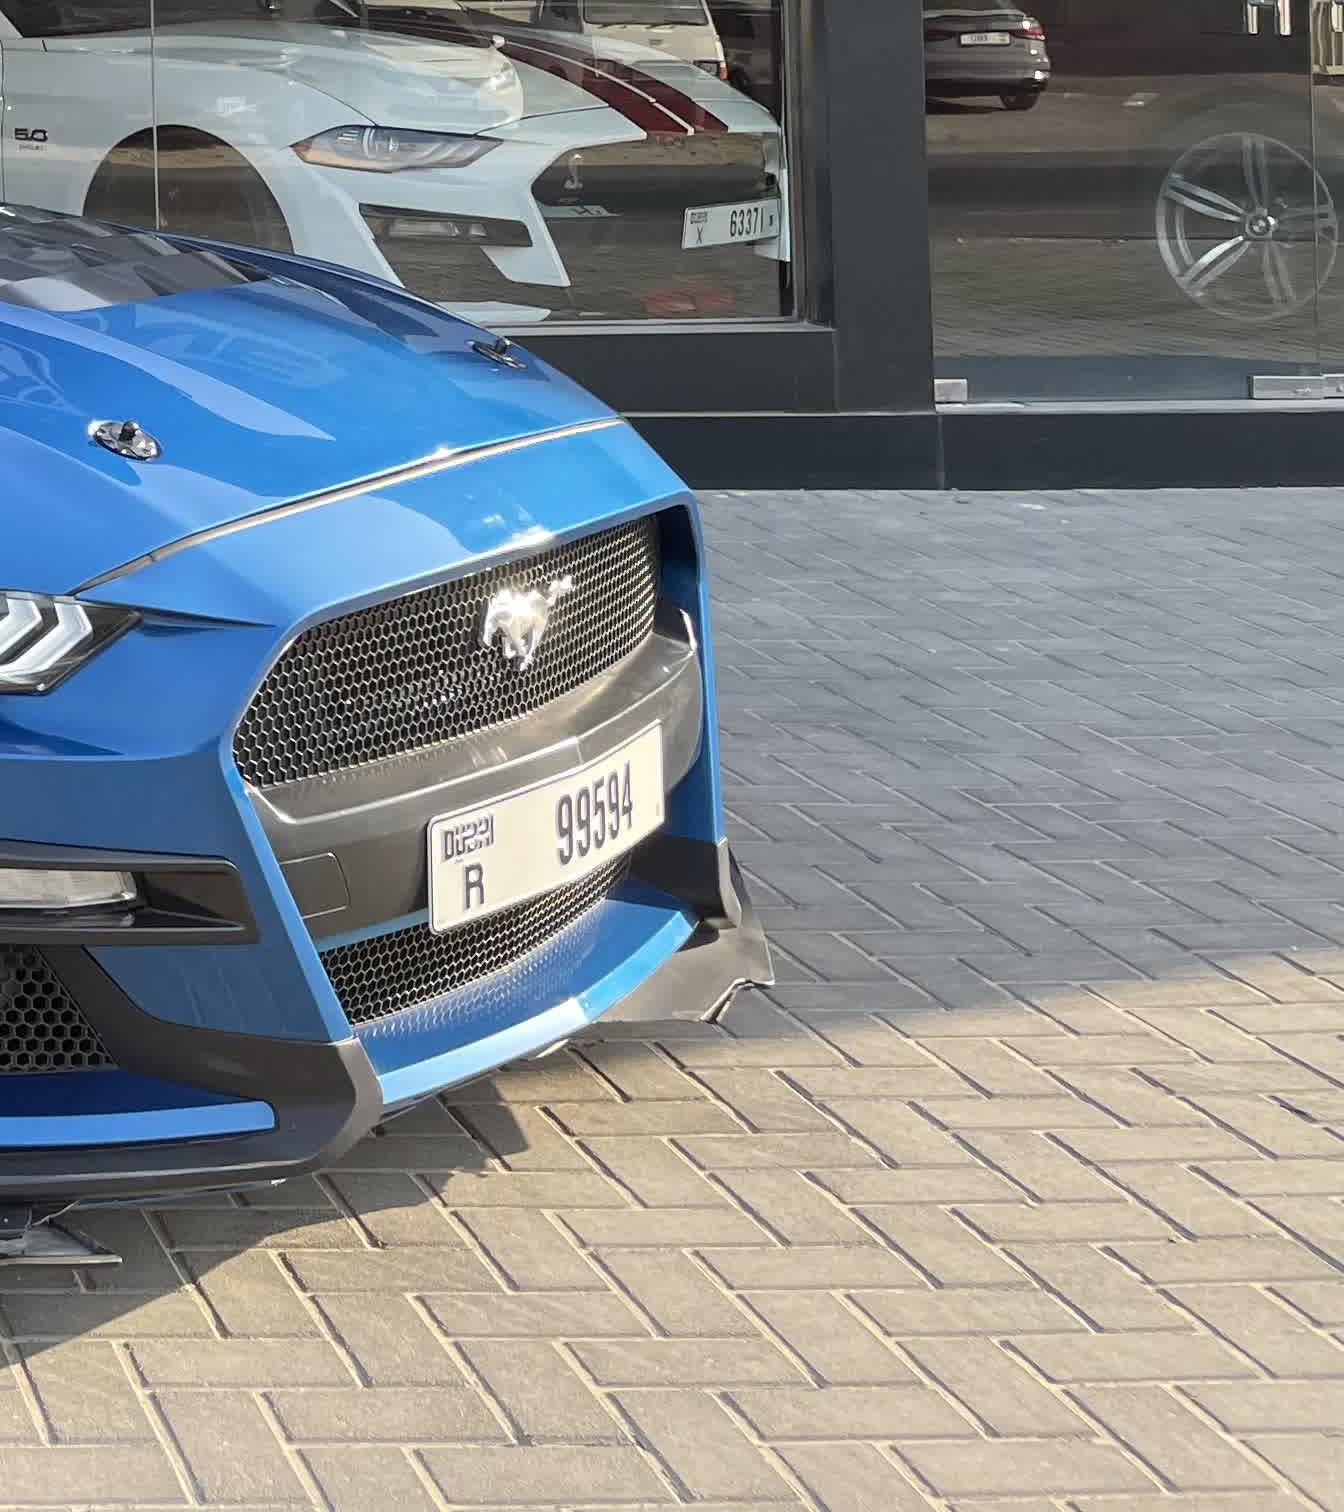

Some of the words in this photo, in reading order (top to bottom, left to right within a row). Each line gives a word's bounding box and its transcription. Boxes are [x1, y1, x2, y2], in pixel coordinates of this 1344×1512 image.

[729, 207, 764, 237] 63371
[555, 760, 633, 866] 99594
[463, 864, 486, 910] R
